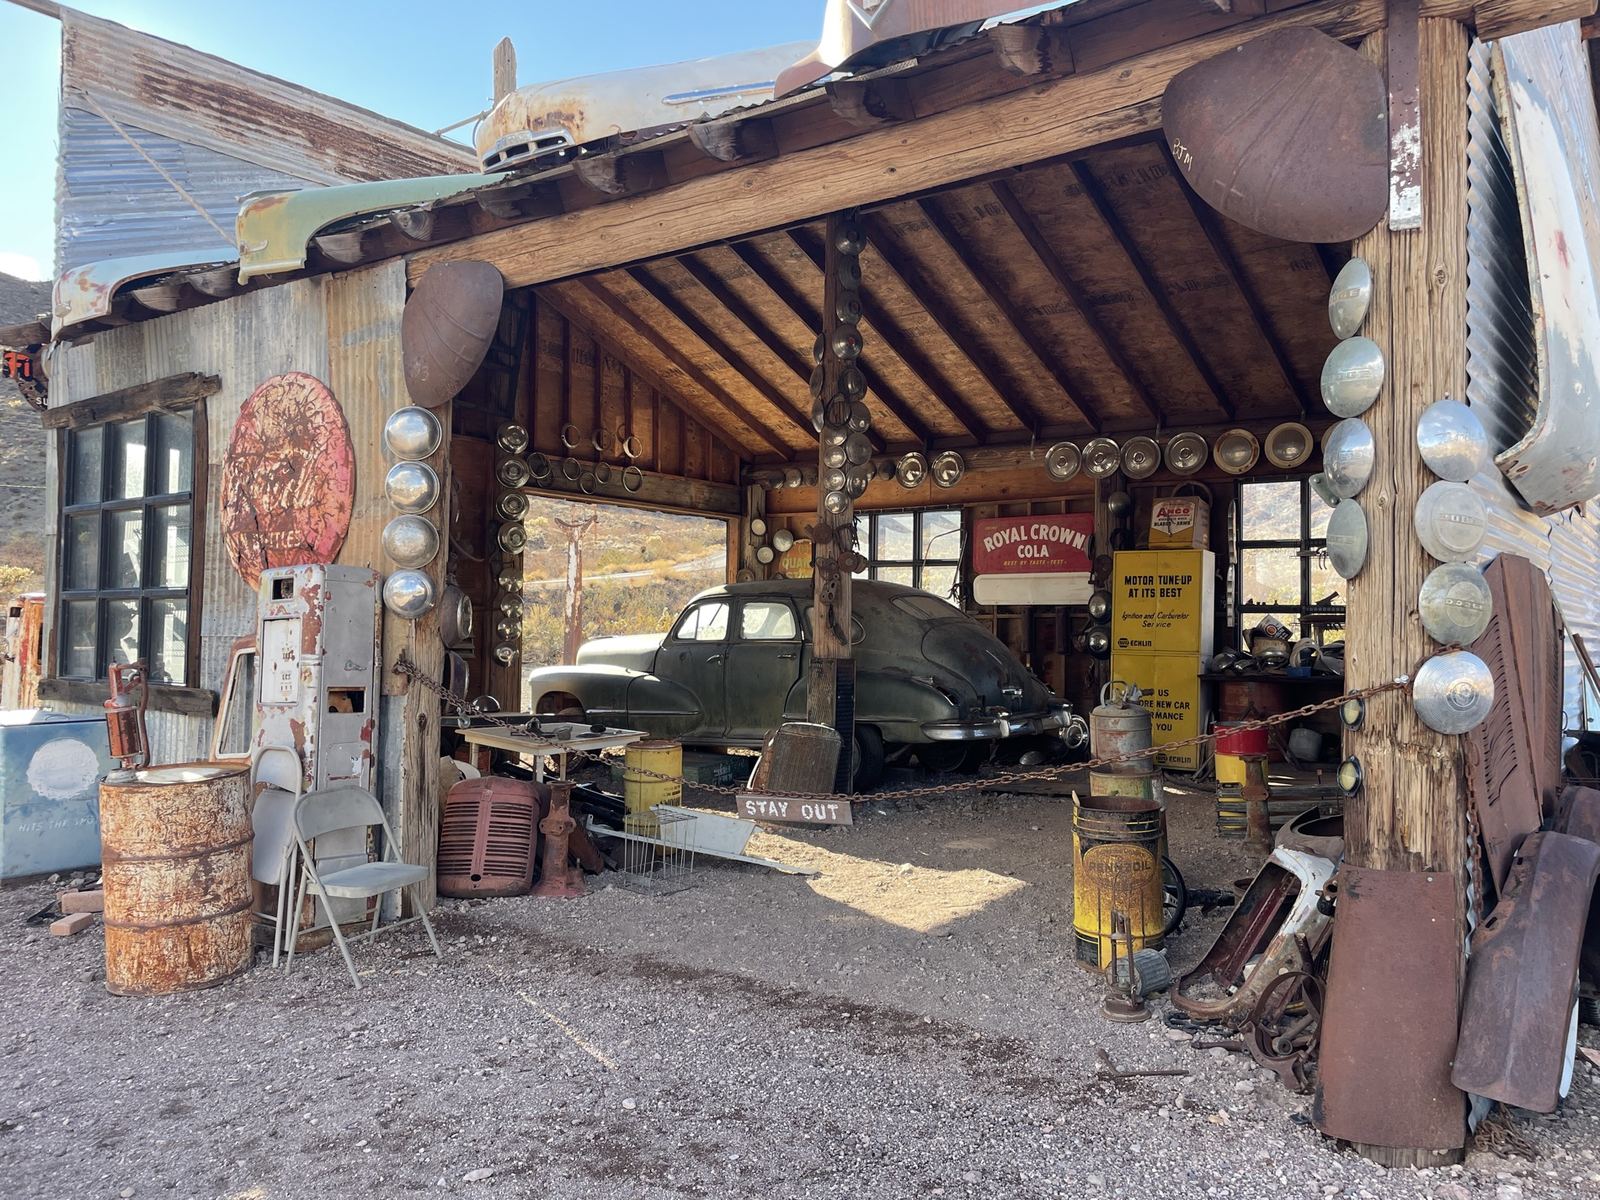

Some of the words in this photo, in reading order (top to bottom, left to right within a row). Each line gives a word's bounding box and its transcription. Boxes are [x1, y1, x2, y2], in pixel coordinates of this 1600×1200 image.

[983, 525, 1028, 553] ROYAL
[1030, 524, 1085, 551] CROWN
[1017, 544, 1050, 558] COLA
[1124, 576, 1154, 585] MOTOR
[1158, 575, 1192, 585] TUNE-UP
[1128, 588, 1139, 598] AT
[1141, 588, 1156, 598] ITS
[1160, 588, 1182, 598] BEST
[1122, 611, 1143, 621] Ignition
[1158, 689, 1169, 697] US
[1139, 700, 1154, 708] ORE
[1156, 700, 1172, 709] NEW
[1174, 701, 1190, 710] CAR
[1151, 712, 1184, 720] RMANCE
[1156, 723, 1172, 731] YOU
[745, 800, 788, 817] STAY
[801, 804, 839, 820] OUT
